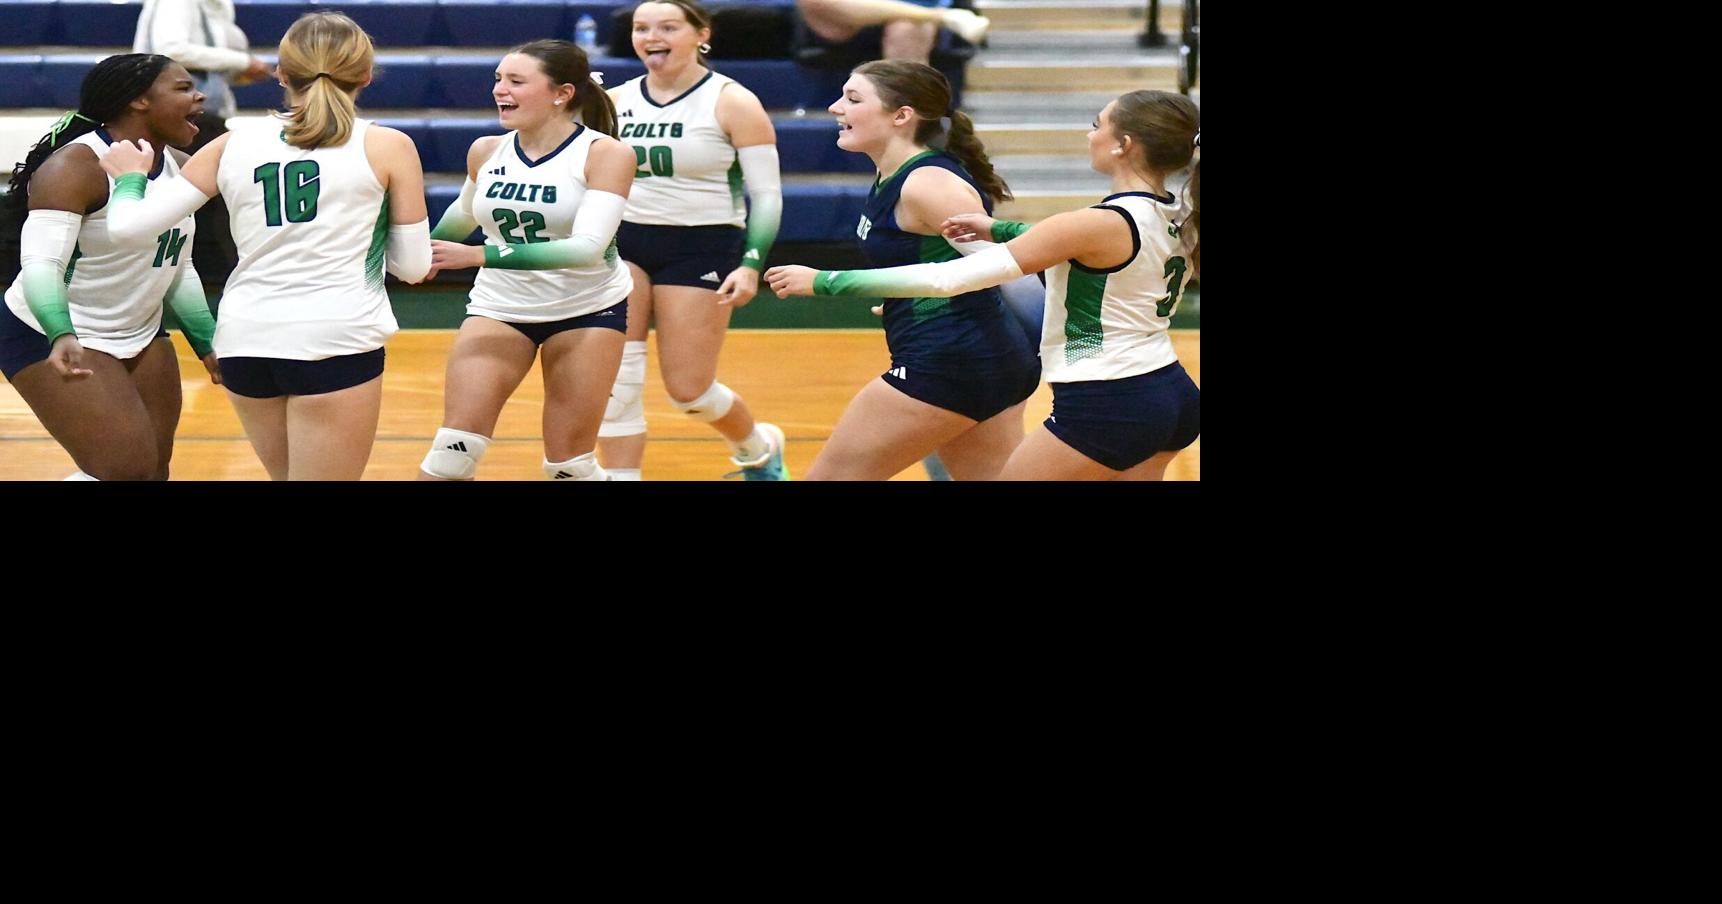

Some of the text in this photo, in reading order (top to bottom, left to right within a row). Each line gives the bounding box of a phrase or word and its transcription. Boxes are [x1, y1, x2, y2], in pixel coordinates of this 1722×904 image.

[620, 122, 683, 138] COLTS
[632, 145, 674, 179] 20
[253, 159, 321, 226] 16
[486, 181, 557, 204] COLTS
[492, 208, 551, 245] 22
[152, 228, 188, 268] 14
